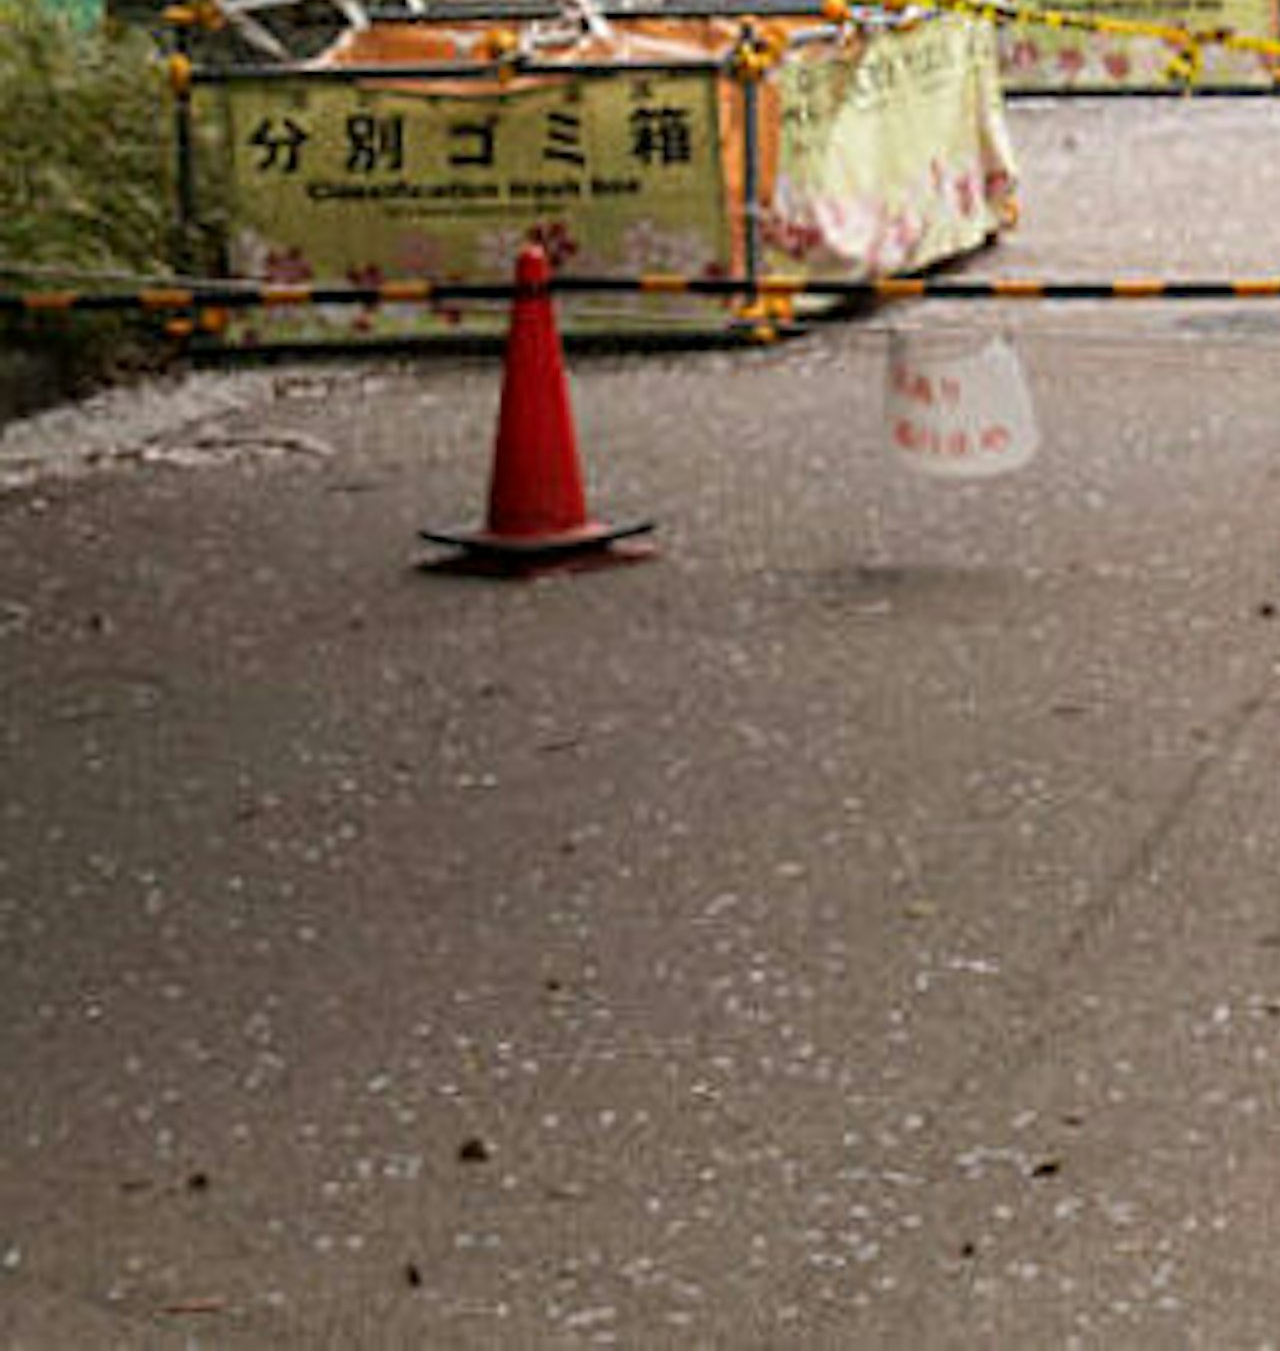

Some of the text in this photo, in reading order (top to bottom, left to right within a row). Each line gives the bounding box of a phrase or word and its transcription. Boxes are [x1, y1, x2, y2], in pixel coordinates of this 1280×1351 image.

[248, 107, 692, 173] 分別ゴミ箱
